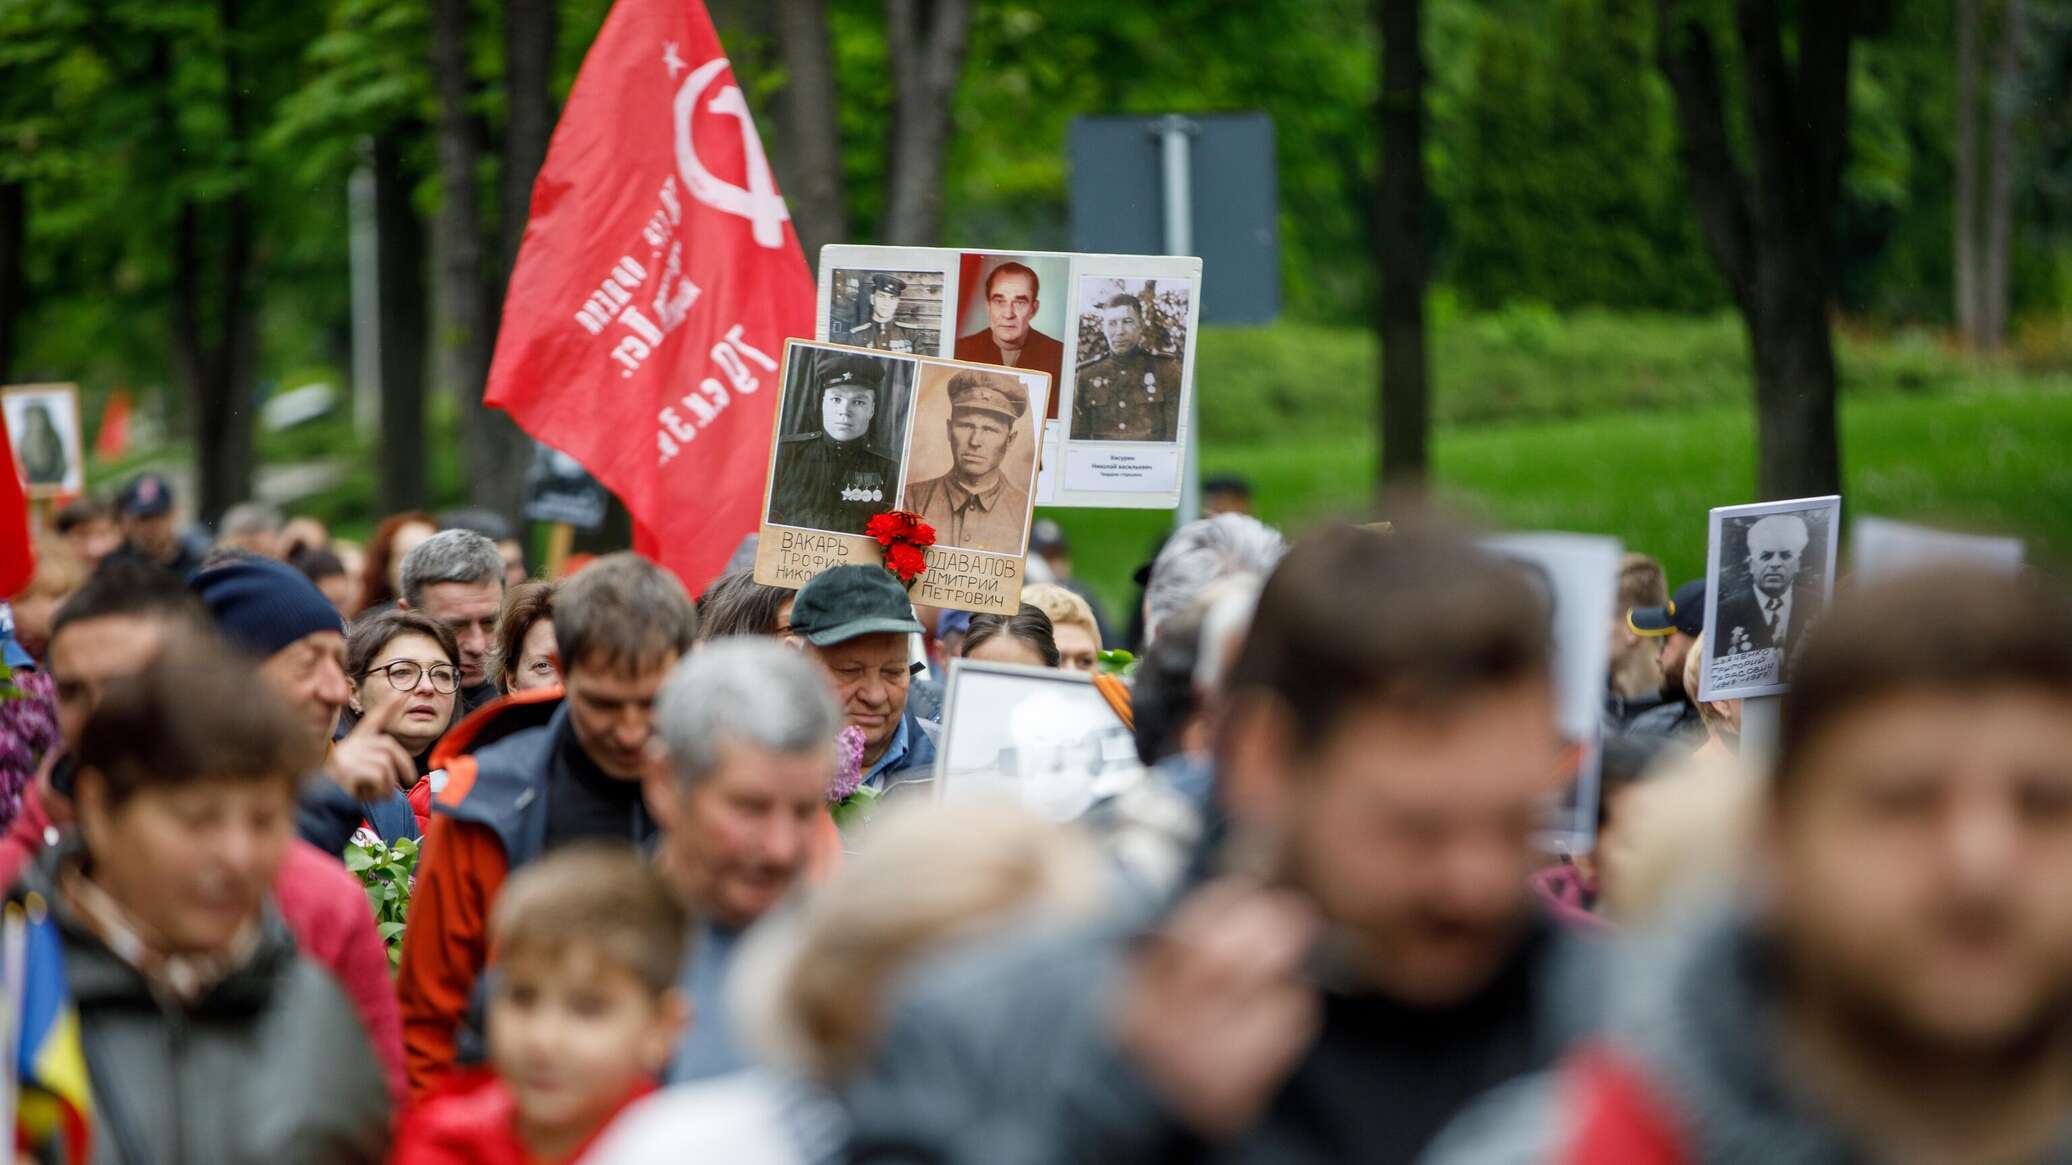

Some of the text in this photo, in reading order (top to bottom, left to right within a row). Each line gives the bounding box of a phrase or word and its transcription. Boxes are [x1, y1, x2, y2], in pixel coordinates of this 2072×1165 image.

[781, 531, 849, 556] ВАКАРЬ
[780, 549, 847, 568] ТРОФИМ
[923, 550, 1016, 579] ОДАВАЛОВ
[775, 564, 817, 582] НИКО
[922, 568, 998, 593] ДМИТРИЙ
[921, 583, 1005, 608] ПЕТРОВИЧ
